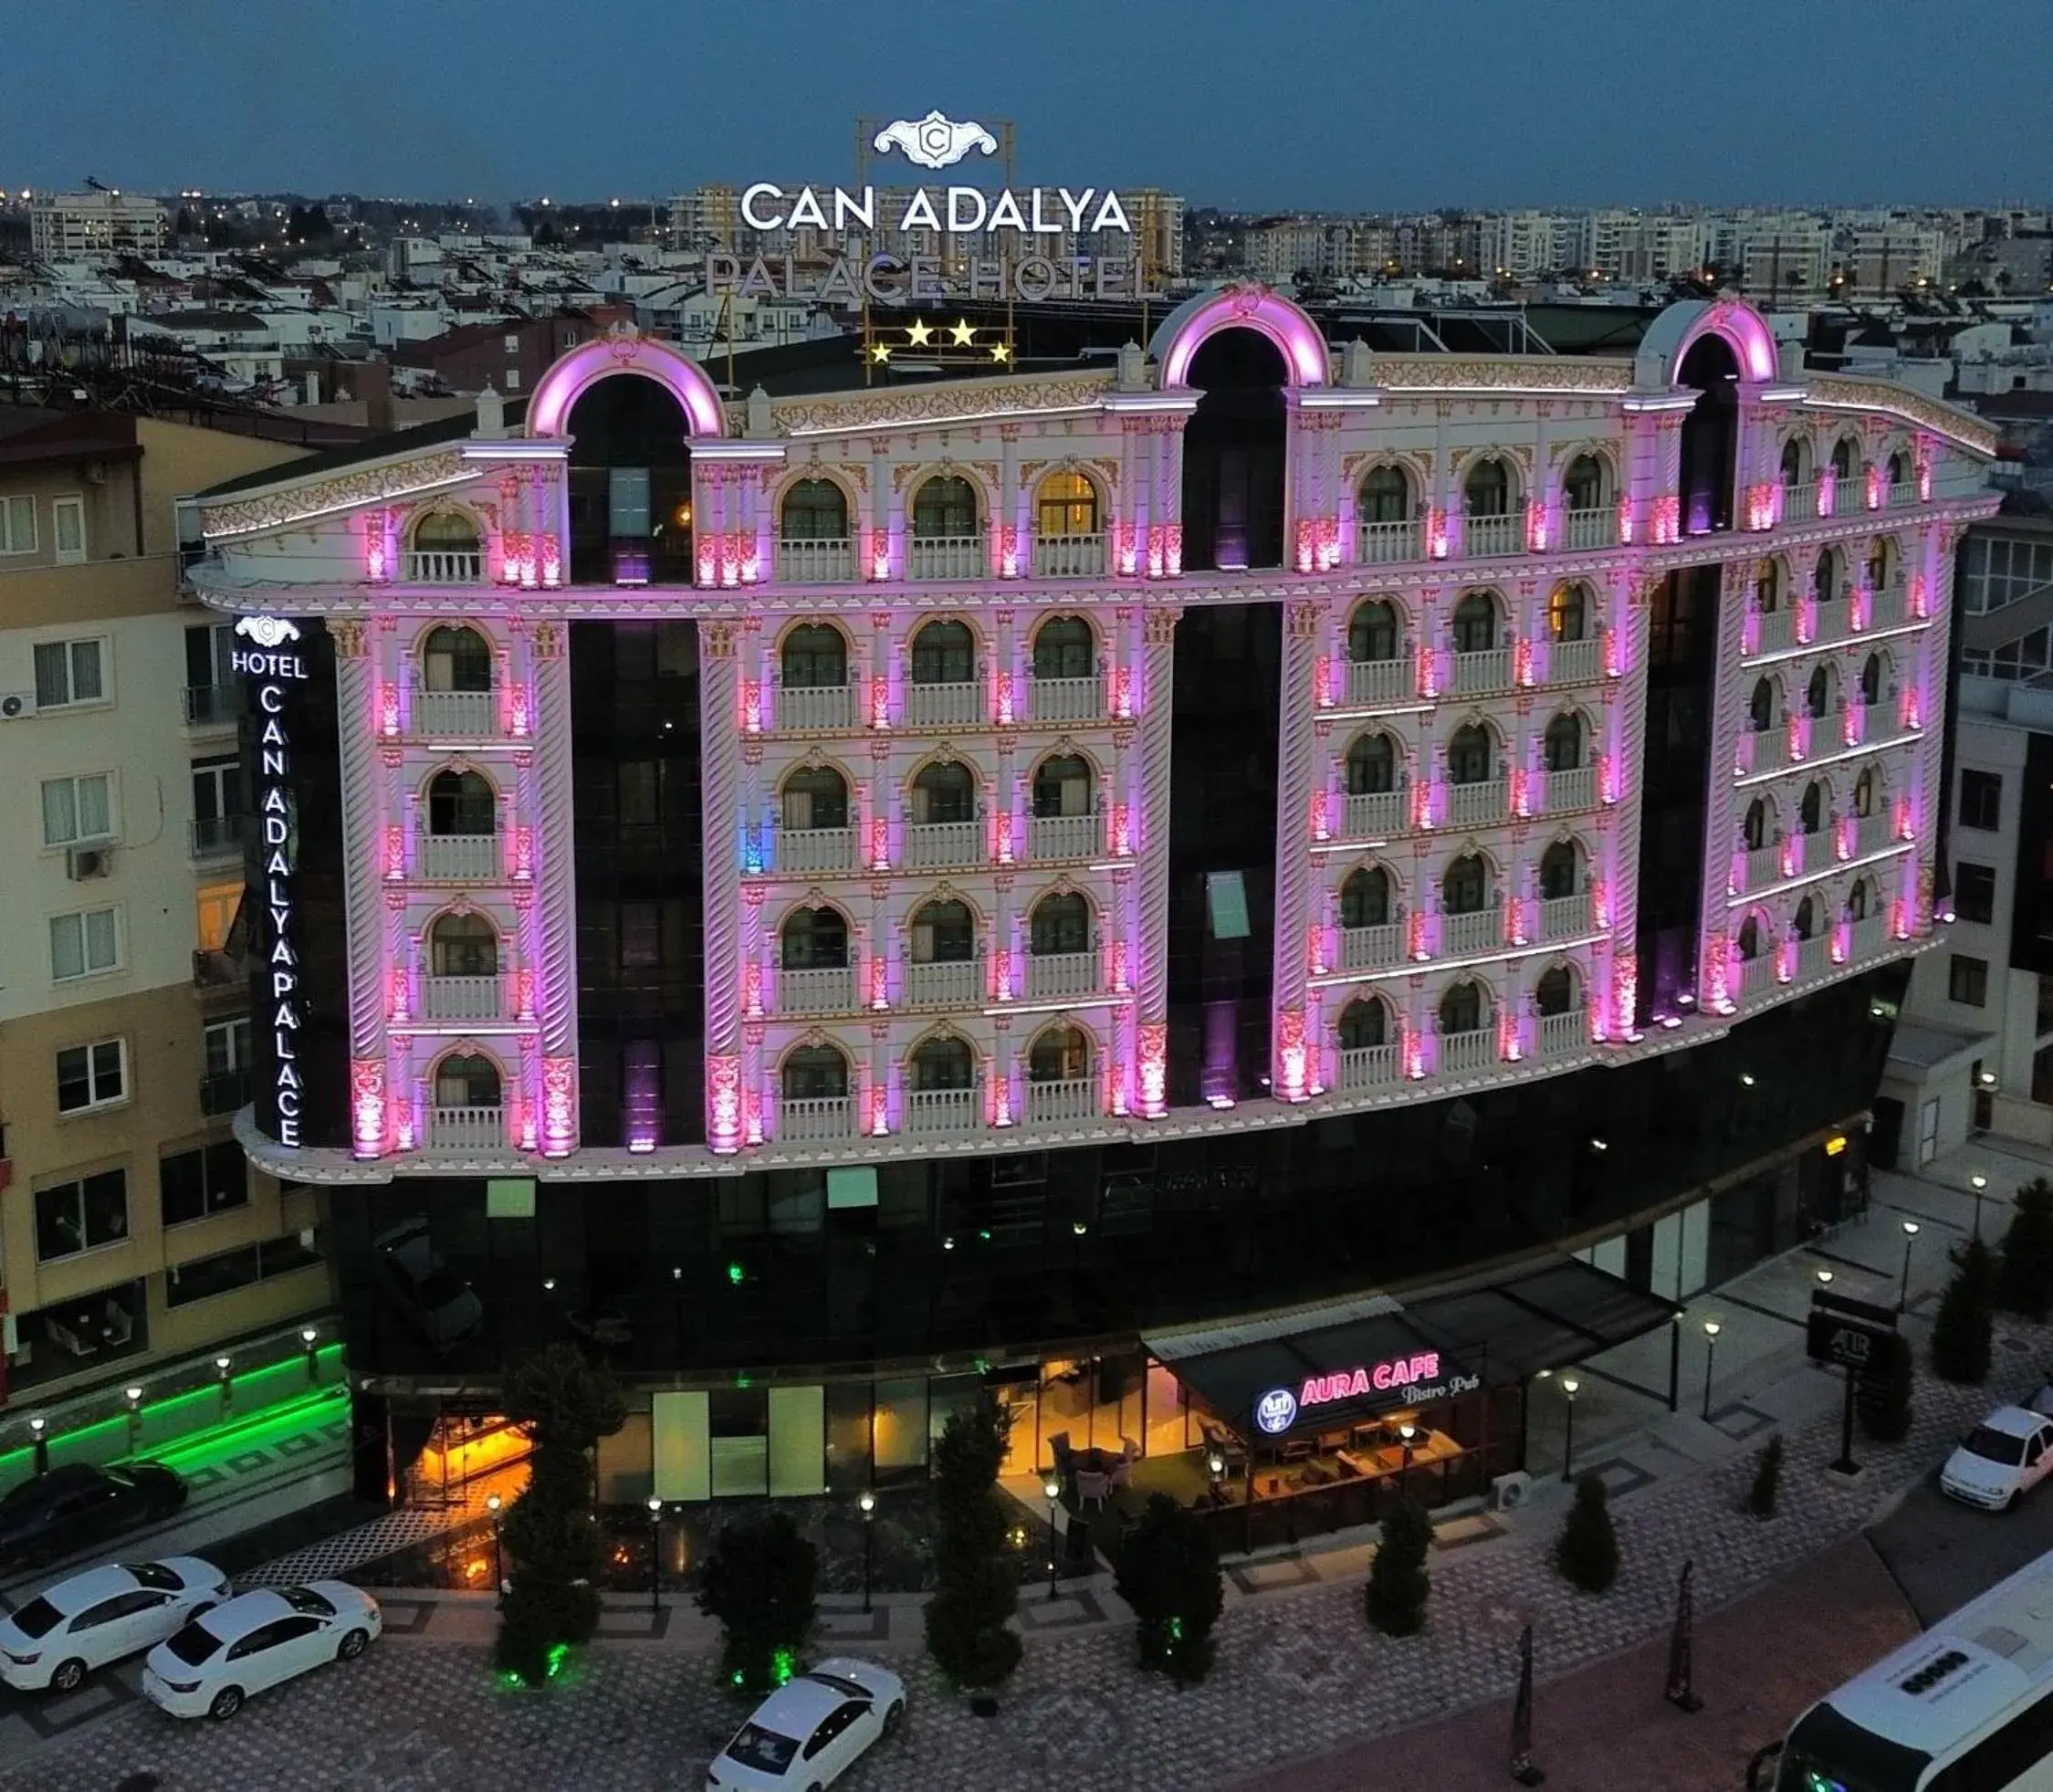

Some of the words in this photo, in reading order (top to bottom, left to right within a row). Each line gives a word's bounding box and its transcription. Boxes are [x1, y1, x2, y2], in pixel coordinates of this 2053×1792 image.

[741, 183, 875, 231] CAN
[900, 187, 1132, 233] ADALYA
[705, 252, 943, 300] PALACE
[970, 255, 1164, 301] HOTEL
[232, 651, 309, 679] HOTEL
[260, 685, 284, 775] CAN
[1300, 1368, 1369, 1406] AURA
[1373, 1353, 1440, 1389] CAFE
[1401, 1385, 1446, 1404] Bistro
[1449, 1374, 1480, 1398] Pub
